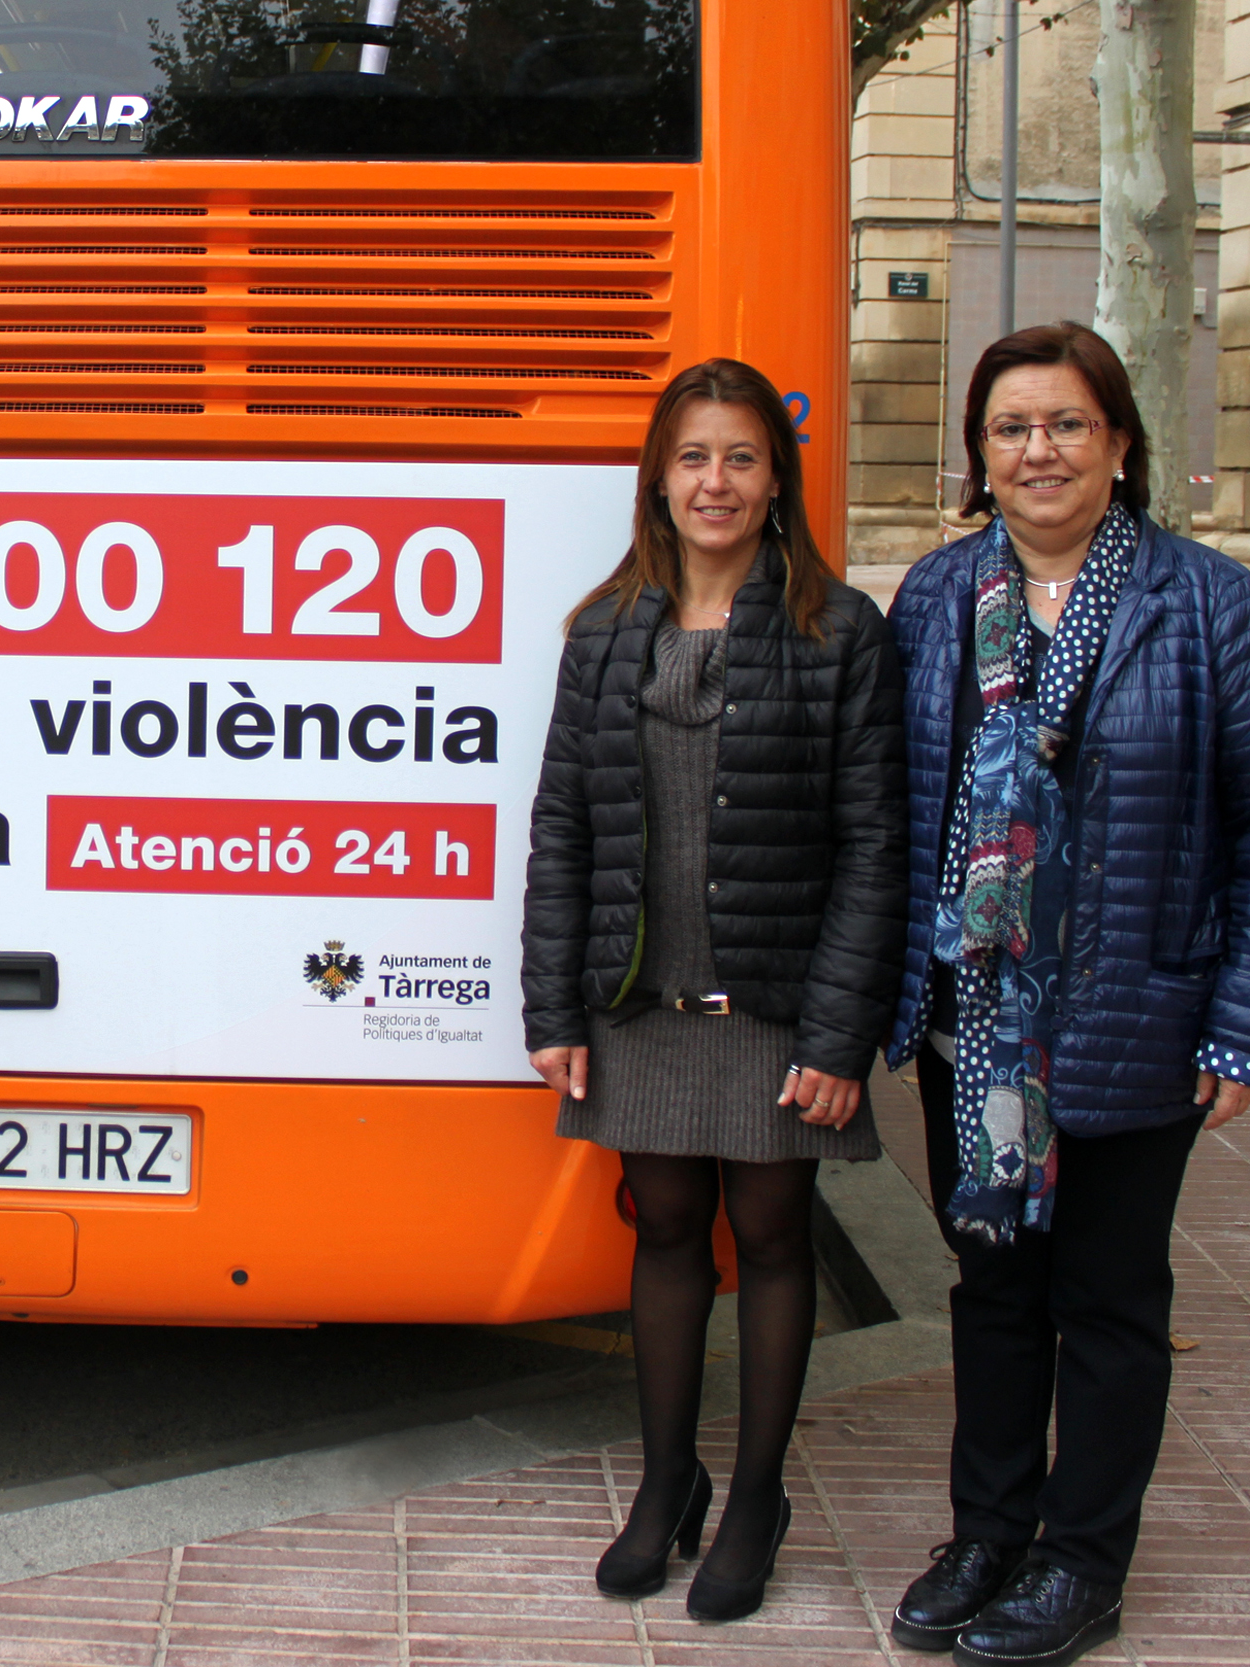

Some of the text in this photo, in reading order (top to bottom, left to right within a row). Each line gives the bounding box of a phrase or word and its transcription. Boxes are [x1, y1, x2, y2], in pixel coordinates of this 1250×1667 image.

[218, 525, 483, 638] 120
[30, 680, 499, 764] violència
[70, 823, 470, 876] Atenció 24 h
[378, 972, 490, 1005] Tàrrega
[379, 954, 491, 970] Ajuntament de
[363, 1013, 440, 1028] Regidoria de
[58, 1122, 173, 1183] HRZ
